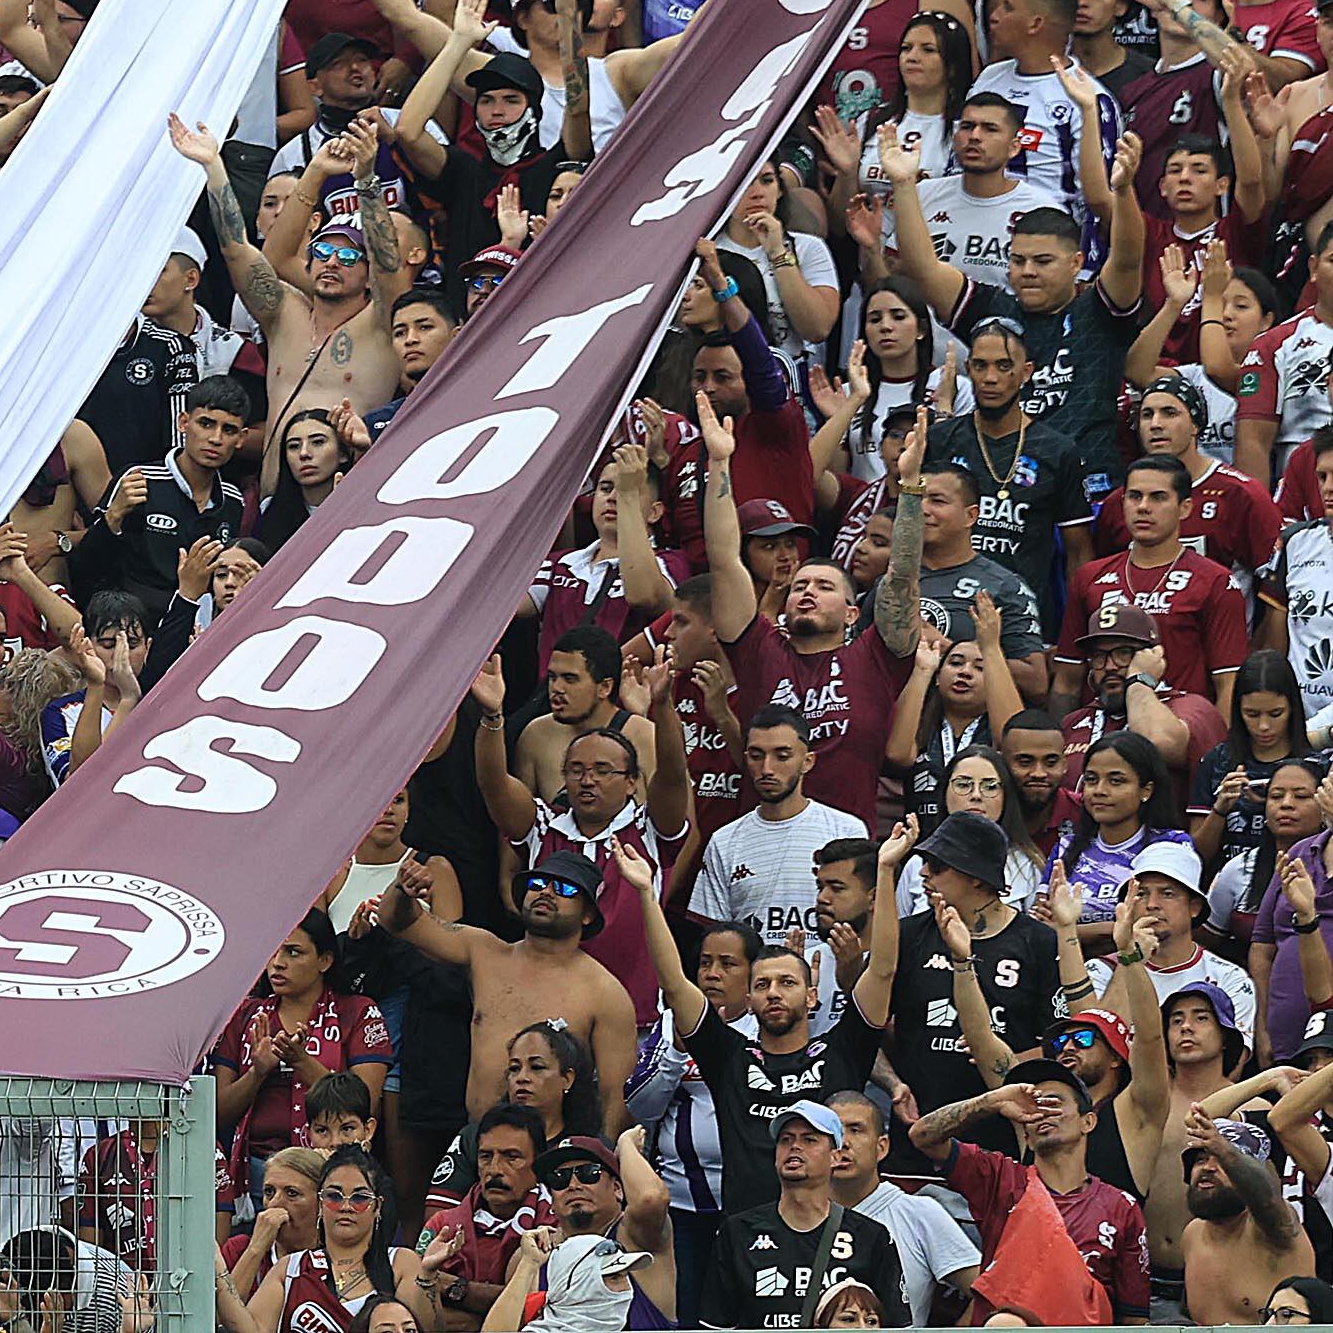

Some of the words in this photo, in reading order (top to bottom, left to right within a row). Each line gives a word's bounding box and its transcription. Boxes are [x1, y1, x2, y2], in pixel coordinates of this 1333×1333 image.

[768, 501, 789, 518] S
[979, 496, 1031, 523] BAC
[1202, 502, 1216, 518] S
[977, 520, 1025, 532] CREDOMATIC
[953, 578, 980, 598] S
[1166, 571, 1192, 590] S
[1100, 606, 1118, 628] S
[803, 680, 849, 710] BAC
[697, 773, 740, 793] BAC
[124, 874, 219, 939] SAPRISSA
[767, 906, 818, 933] BAC
[995, 960, 1020, 987] S
[57, 978, 156, 997] RICA
[1304, 1012, 1326, 1039] S
[831, 1232, 853, 1259] S
[1099, 1222, 1116, 1249] S
